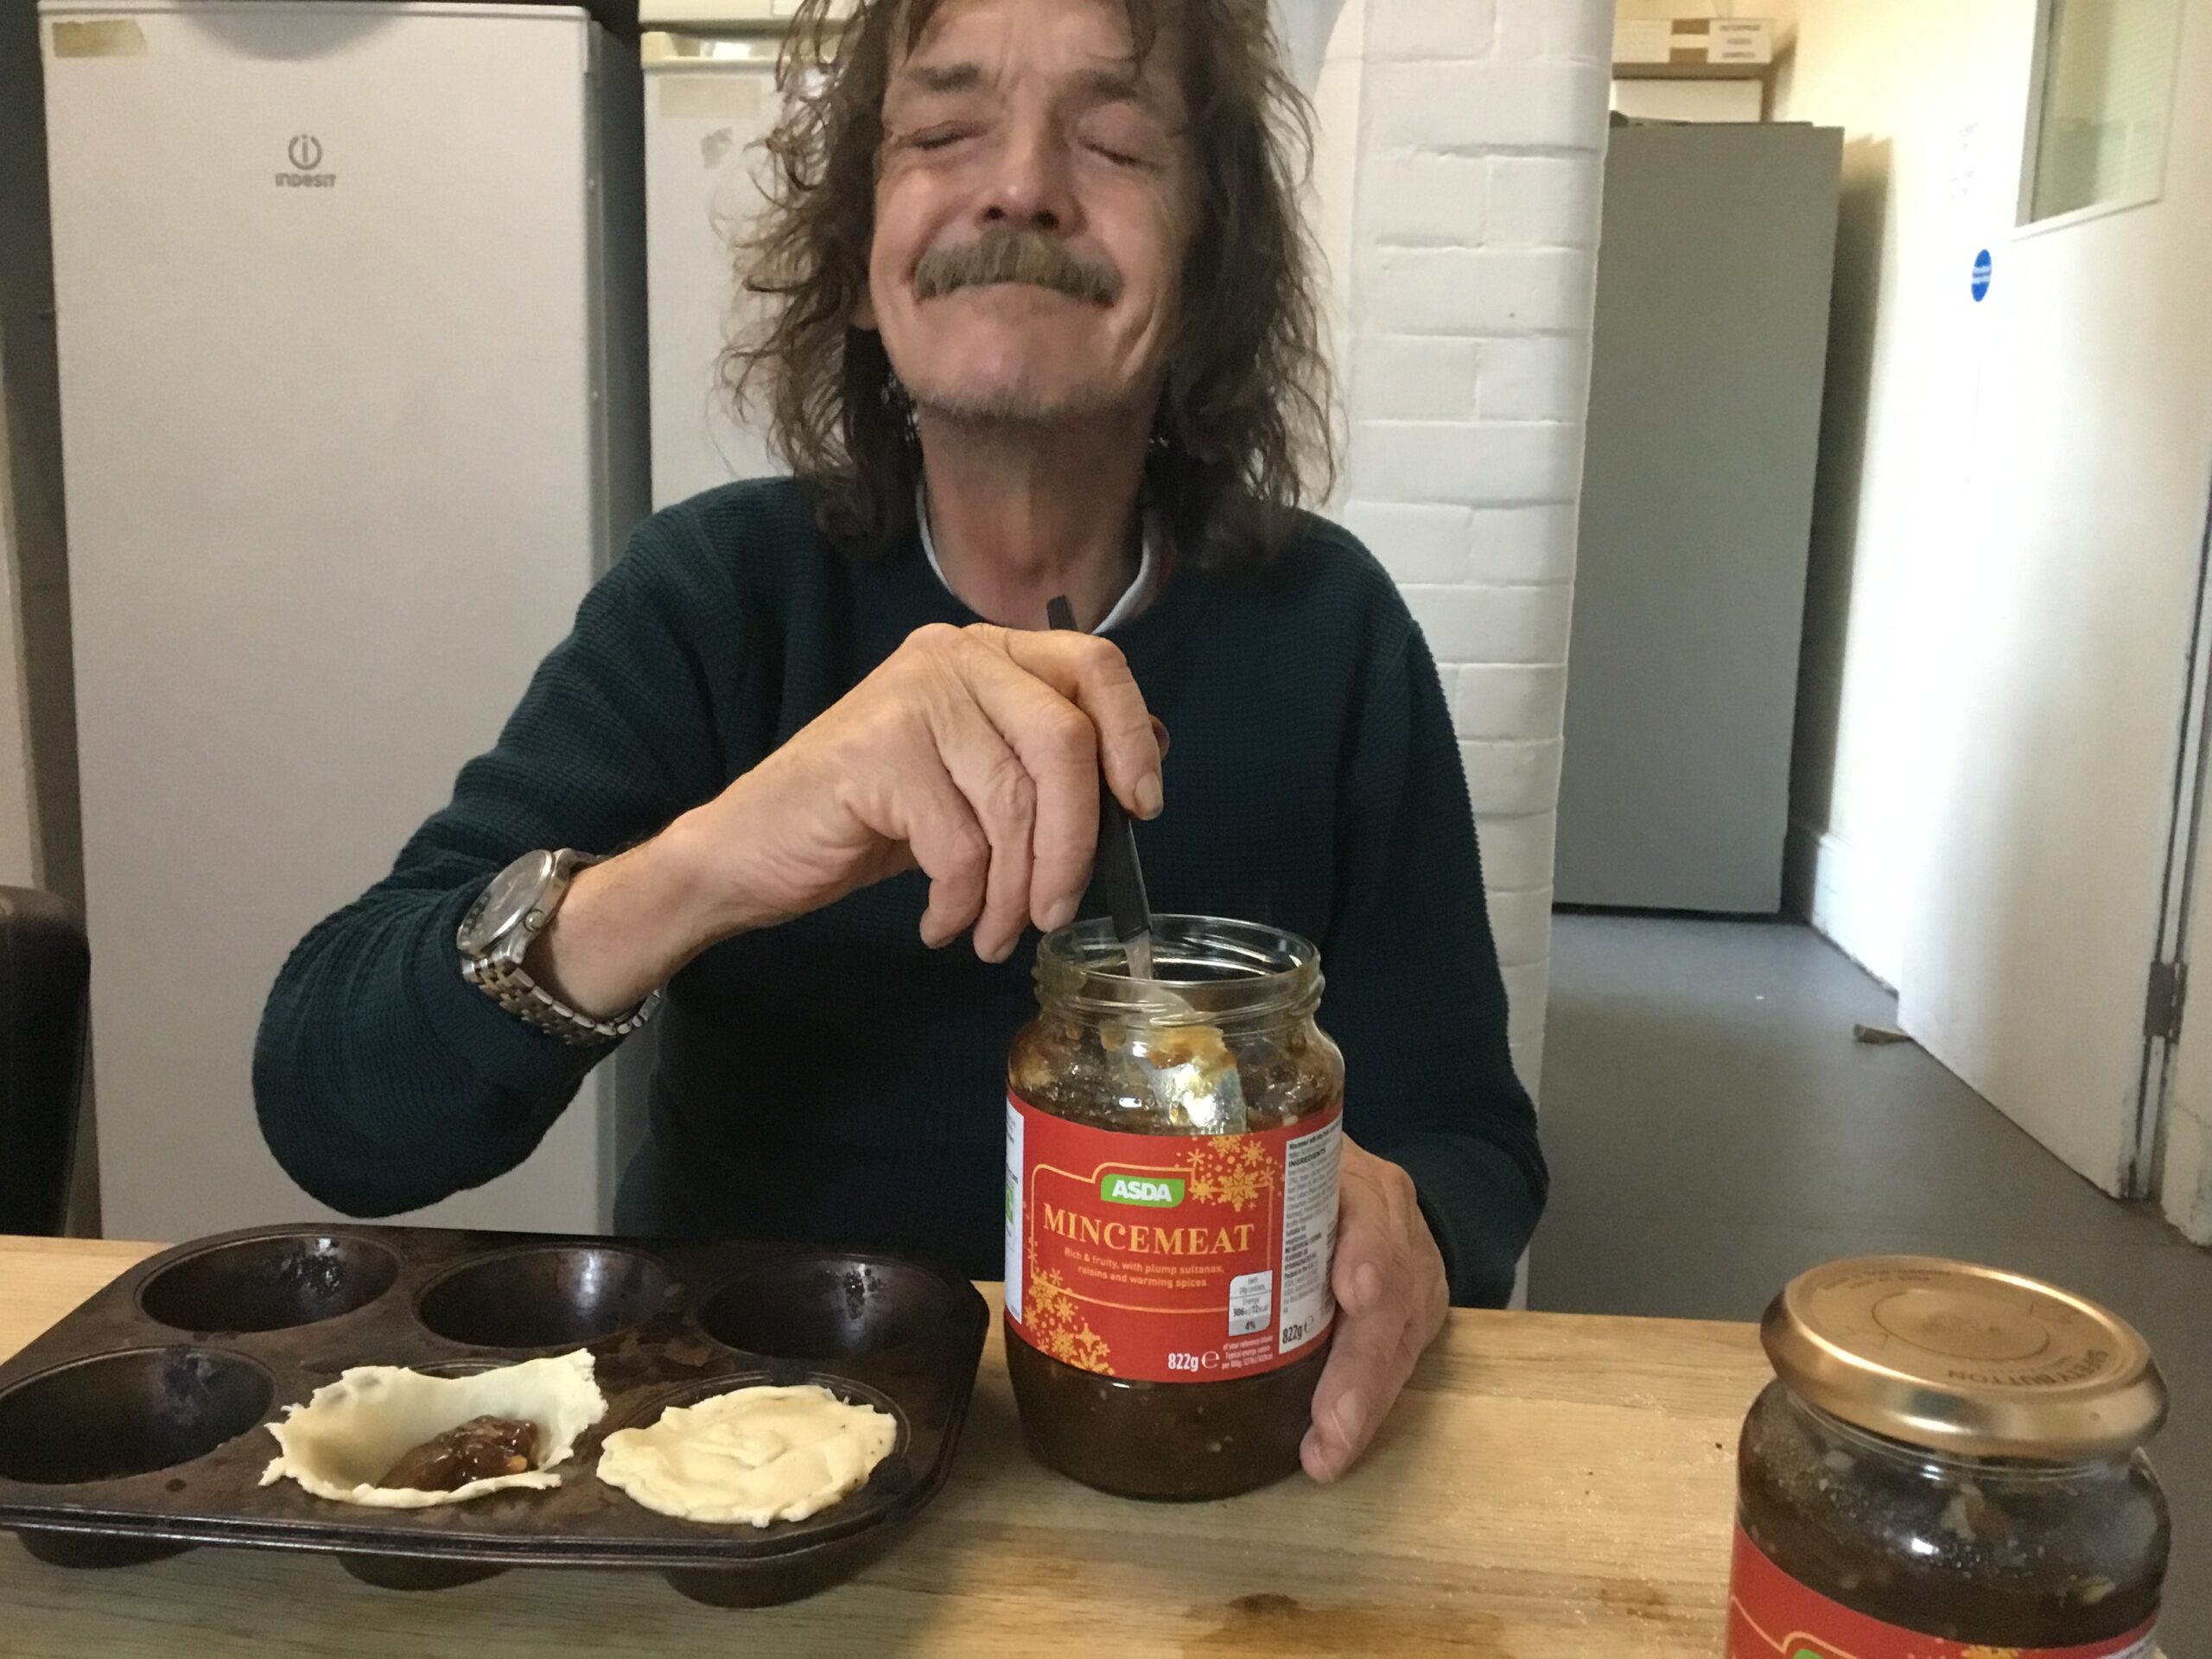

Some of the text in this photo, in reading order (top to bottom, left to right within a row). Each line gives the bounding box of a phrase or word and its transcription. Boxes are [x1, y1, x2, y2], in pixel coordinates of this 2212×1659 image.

[1111, 1179, 1173, 1202] ASDA
[1043, 1202, 1255, 1255] MINCEMEAT
[1064, 1247, 1224, 1275] Rich & fruity, with plump sultanas,
[1077, 1265, 1208, 1290] raisins and warming spices
[1281, 1324, 1303, 1344] 822g
[1167, 1352, 1199, 1372] 822g
[1948, 1370, 2056, 1386] BUTTON
